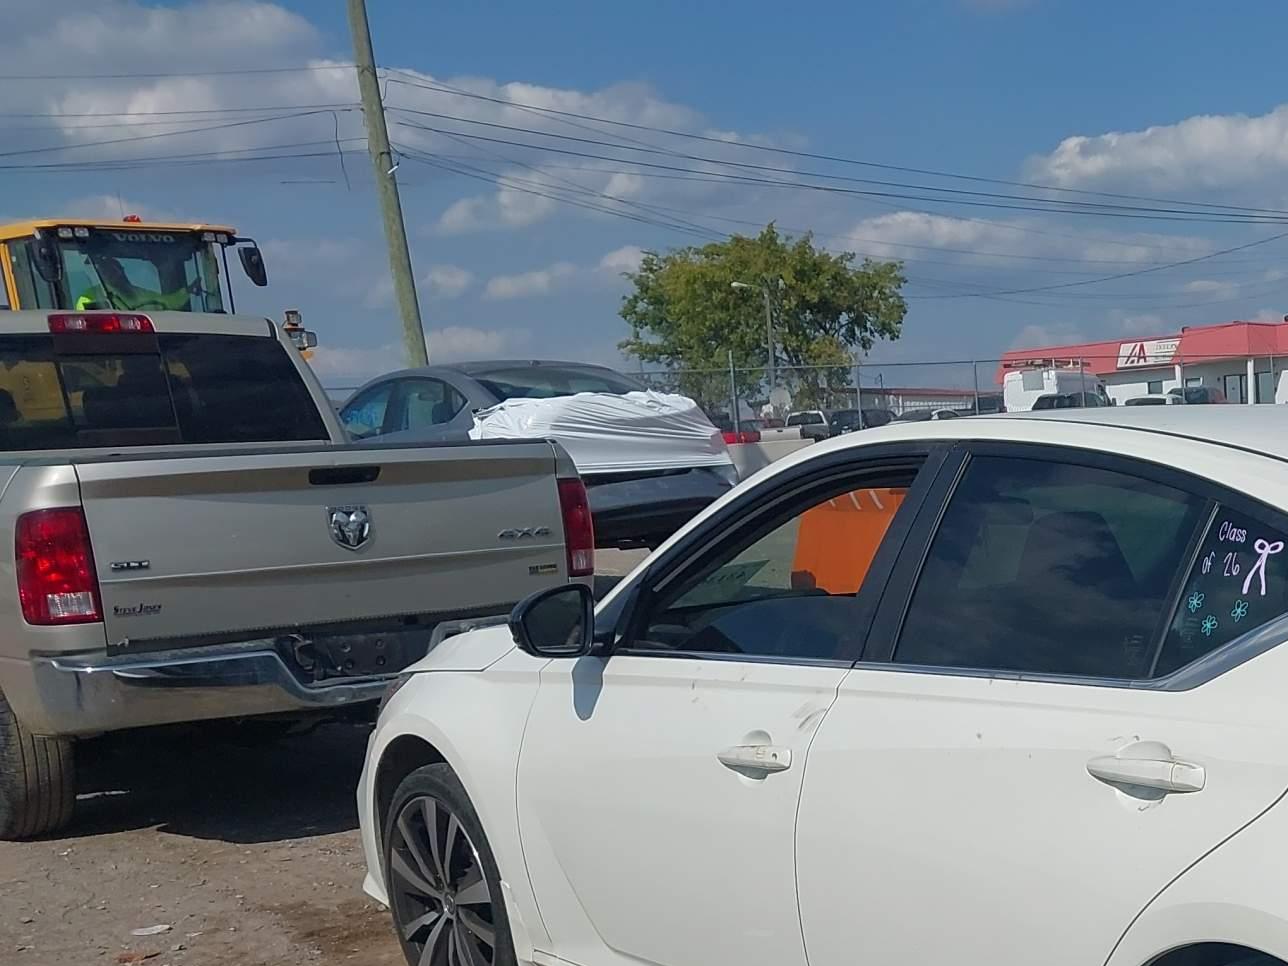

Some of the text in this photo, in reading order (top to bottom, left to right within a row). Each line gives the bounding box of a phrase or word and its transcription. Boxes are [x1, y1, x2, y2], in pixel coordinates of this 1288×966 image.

[112, 233, 176, 242] VOLVO
[1219, 521, 1247, 543] Class
[1202, 551, 1240, 577] of 26
